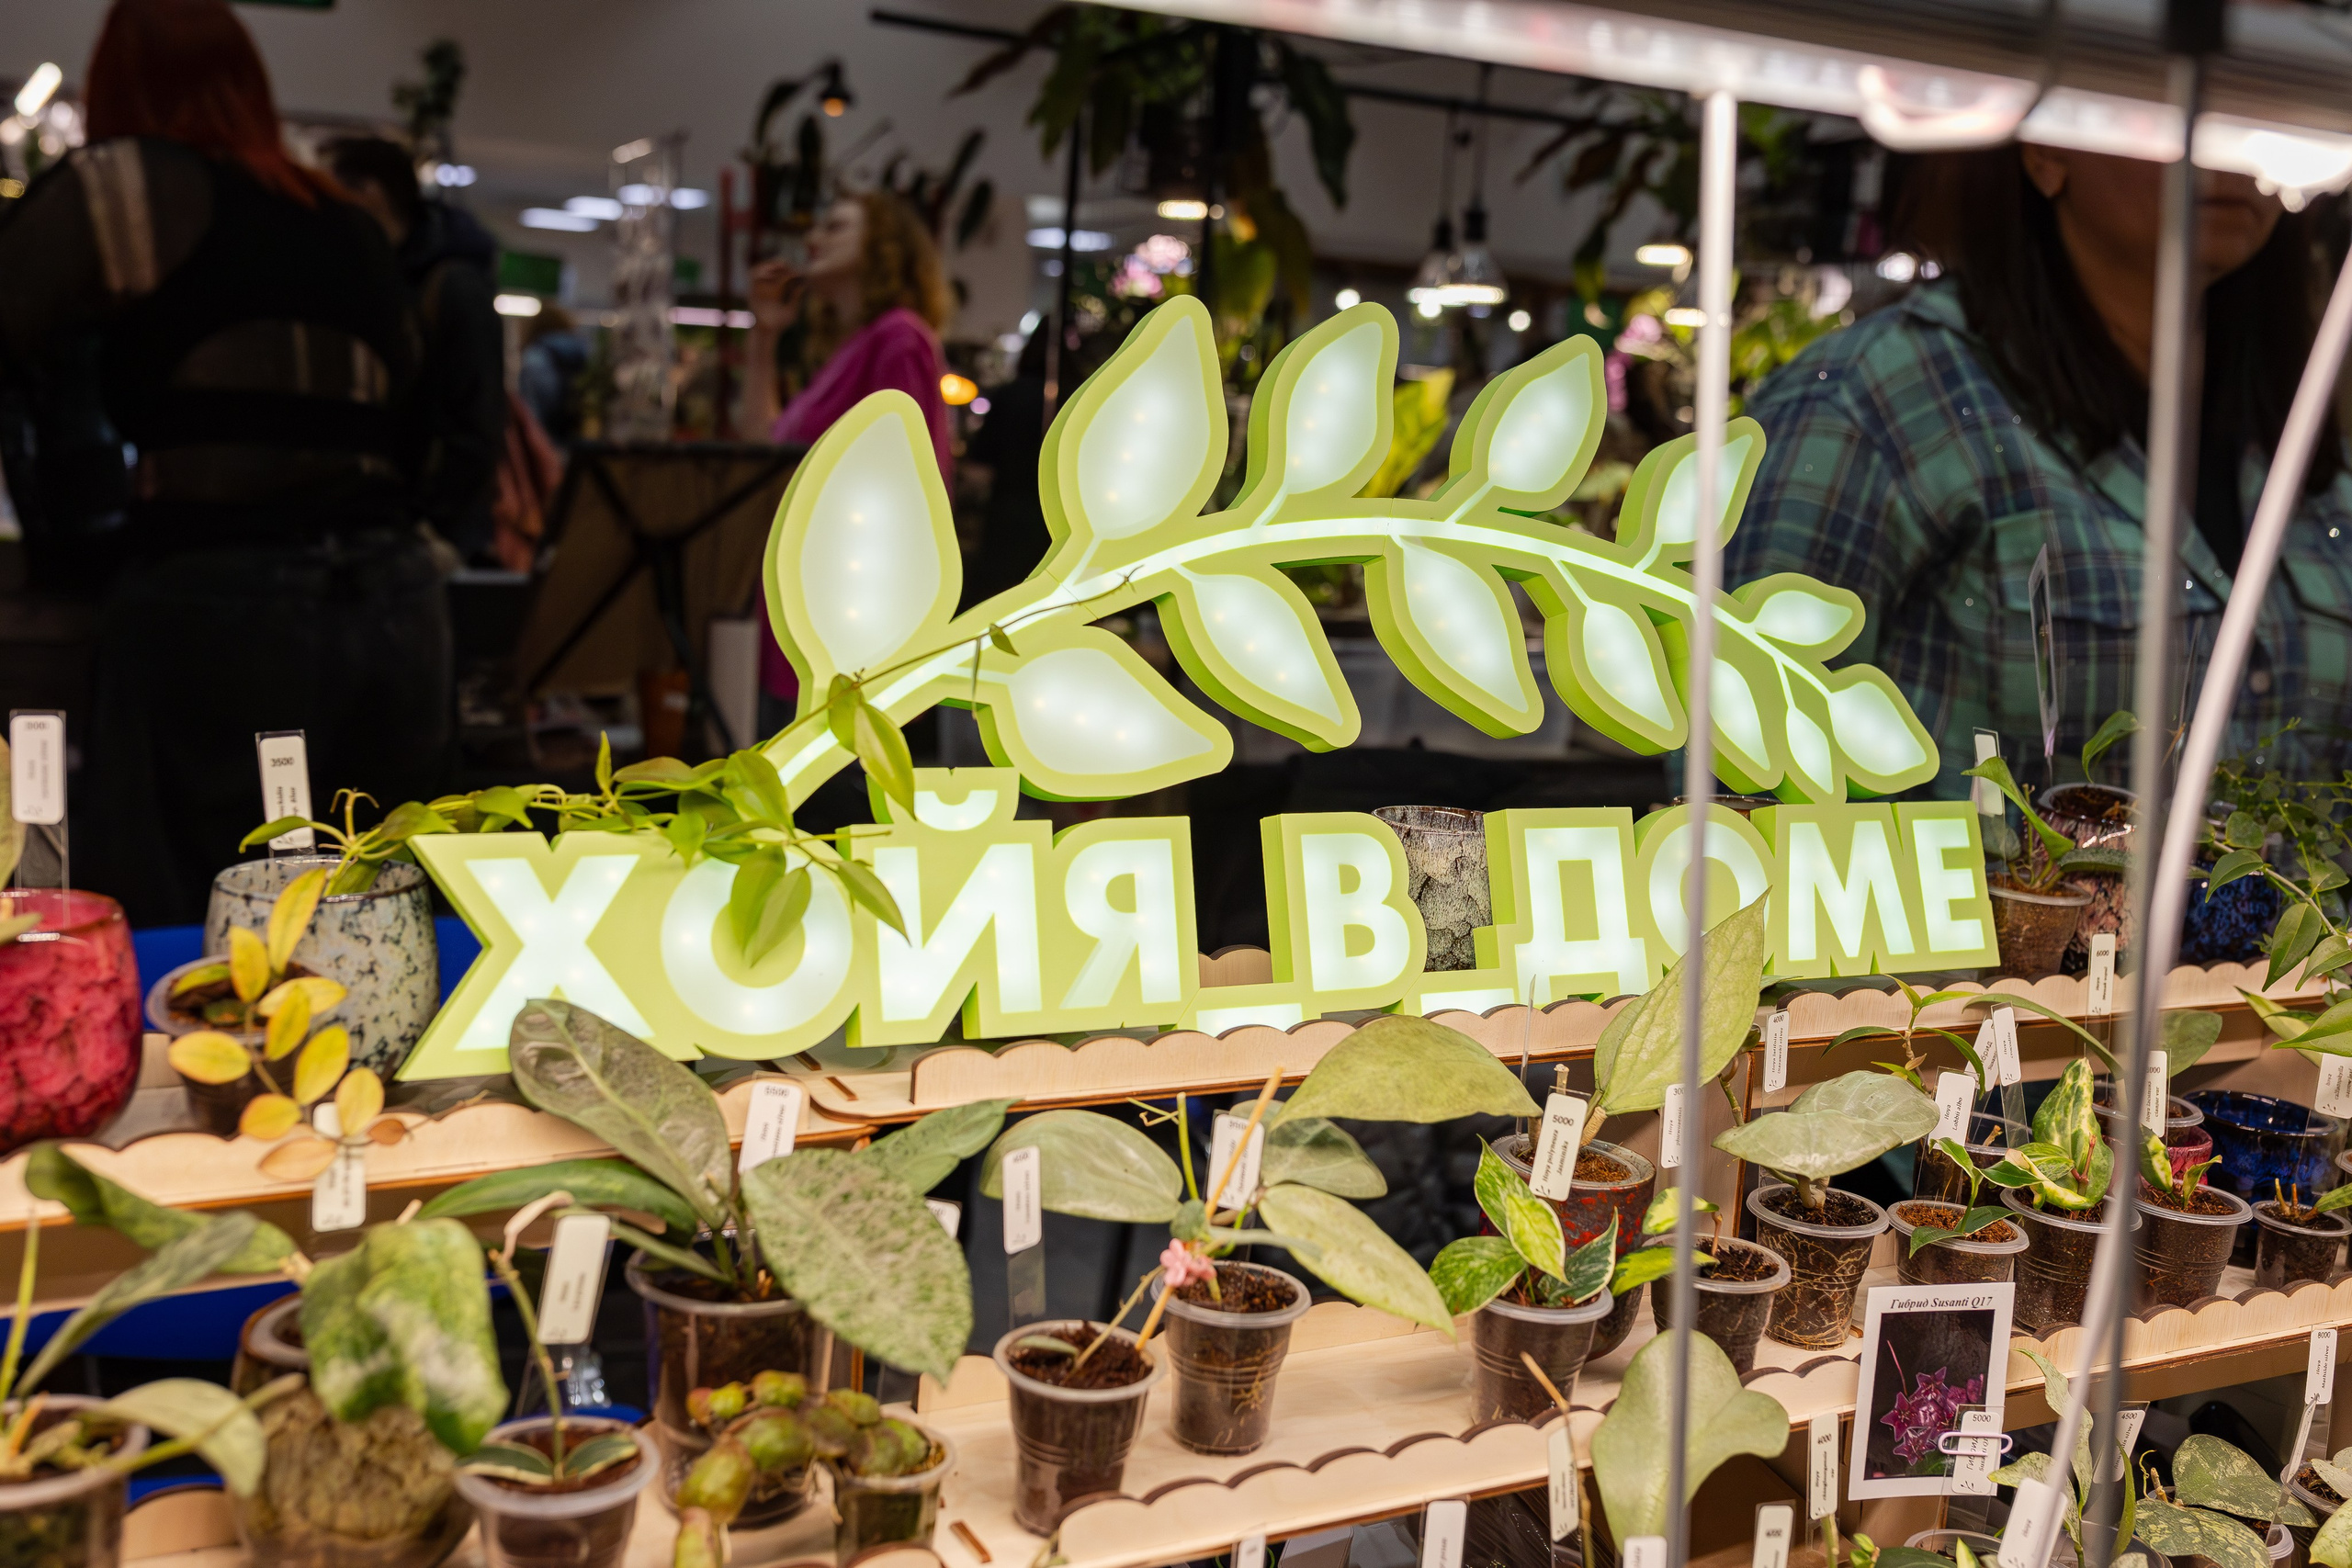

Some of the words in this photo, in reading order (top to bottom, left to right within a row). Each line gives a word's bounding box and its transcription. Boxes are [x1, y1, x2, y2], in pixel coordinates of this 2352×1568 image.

[454, 789, 1182, 1051] ХОЙЯ
[1300, 832, 1410, 993] В
[1514, 818, 1984, 1005] ДОМЕ
[1553, 1114, 1574, 1126] 5000
[1952, 1111, 1961, 1131] Lobbii
[1542, 1165, 1552, 1182] Hoya
[1890, 1298, 1928, 1311] Гибрид
[1930, 1297, 1969, 1308] Susanti
[1971, 1296, 1993, 1309] Q17
[1973, 1415, 1992, 1423] 5000
